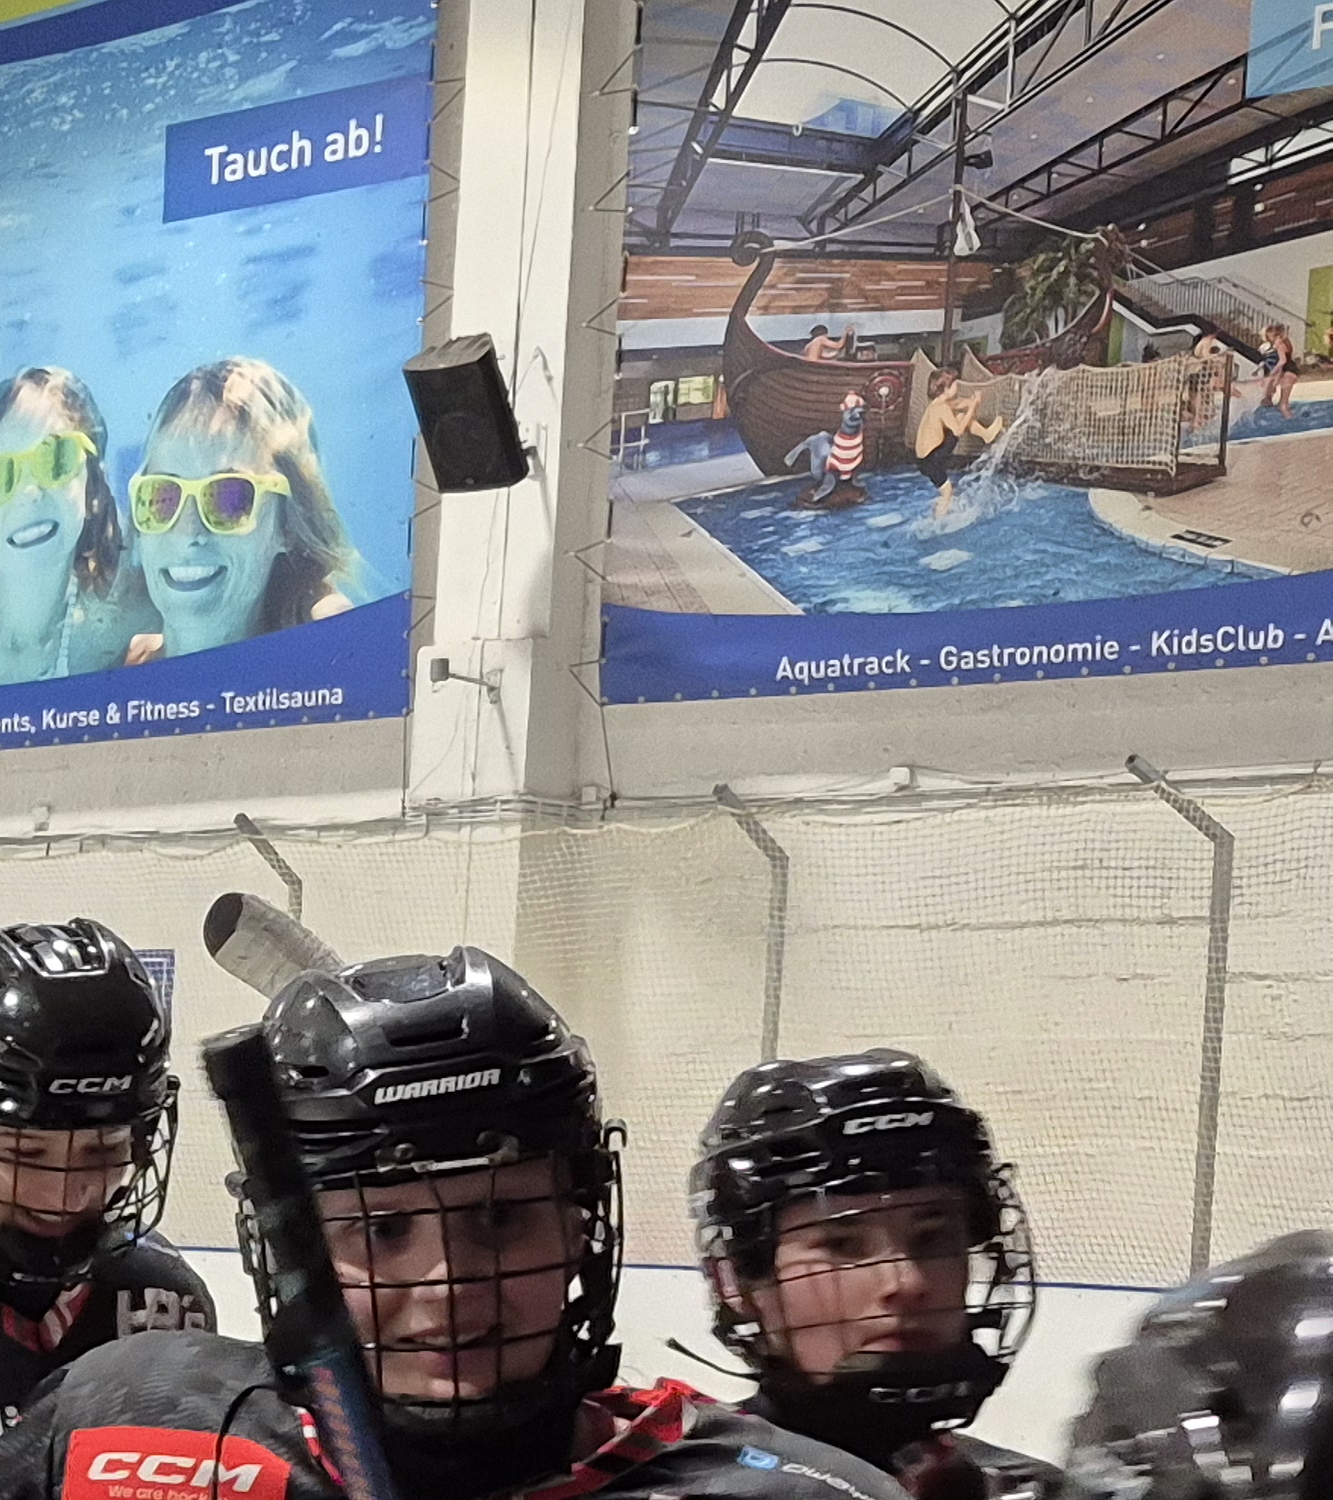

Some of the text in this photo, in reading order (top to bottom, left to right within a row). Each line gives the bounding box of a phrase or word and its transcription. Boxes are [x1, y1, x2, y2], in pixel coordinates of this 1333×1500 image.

[204, 113, 386, 186] Tauch ab!
[776, 648, 911, 685] Aquatrack
[939, 635, 1120, 672] Gastronomie
[1150, 622, 1284, 656] KidsClub
[42, 708, 100, 731] Kurse
[106, 702, 120, 726] &
[127, 699, 200, 723] Fitness
[221, 687, 343, 714] Textilsauna
[48, 1074, 133, 1094] CCM
[374, 1068, 501, 1105] WARRIOR
[87, 1452, 263, 1492] CCM
[108, 1485, 133, 1498] We
[136, 1487, 163, 1500] are
